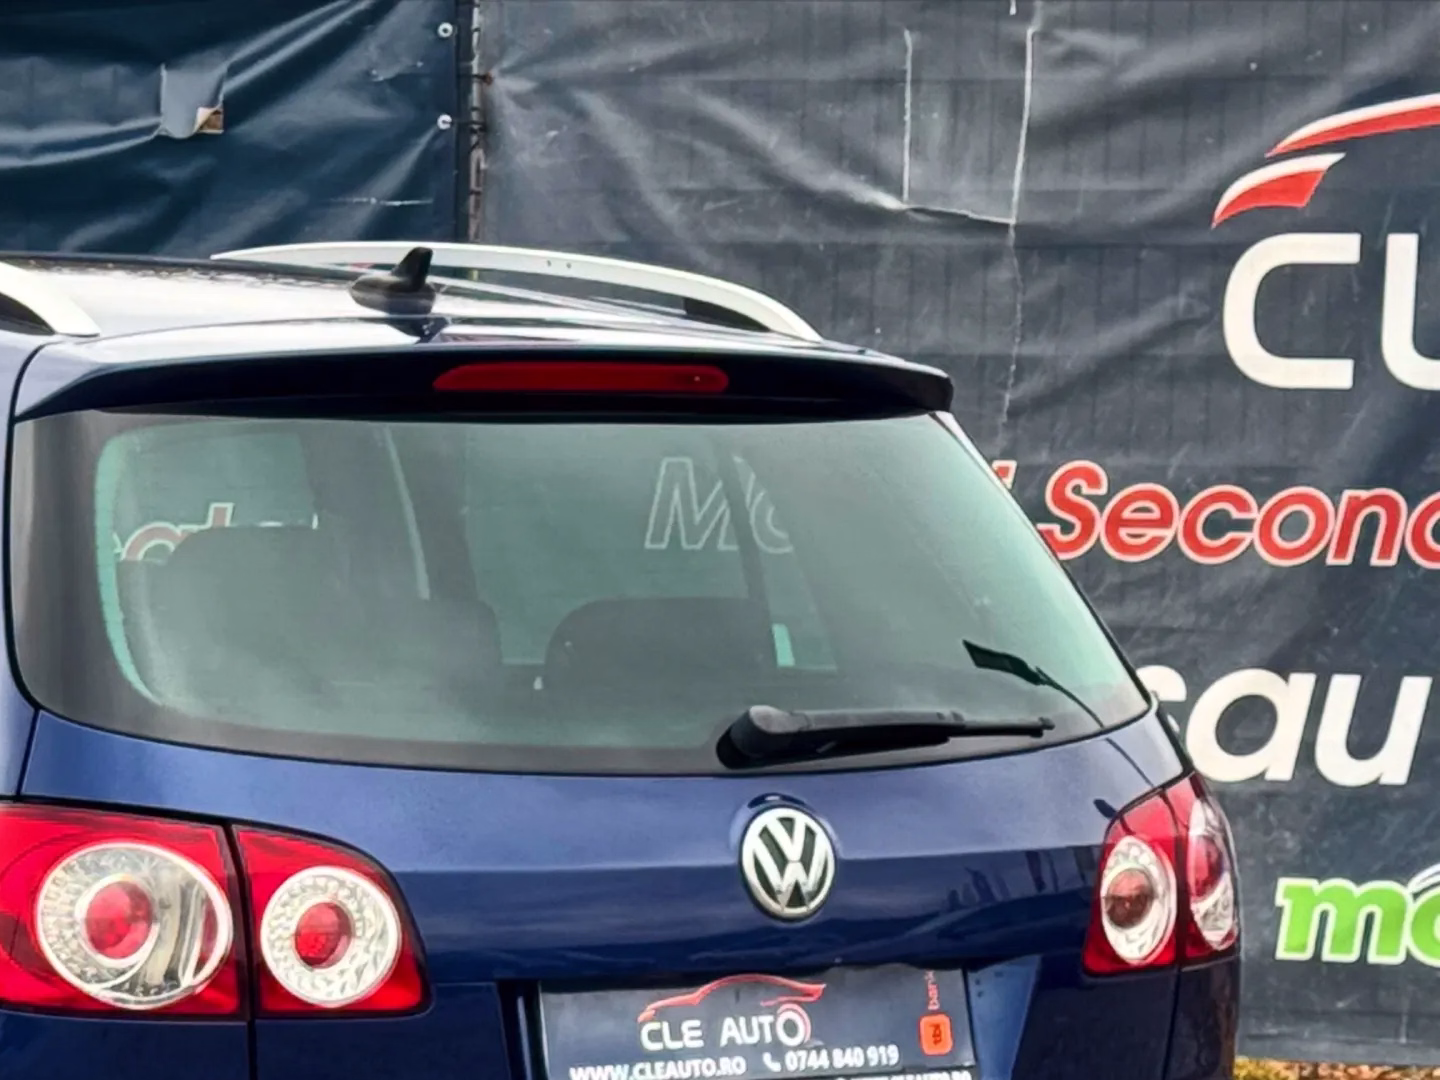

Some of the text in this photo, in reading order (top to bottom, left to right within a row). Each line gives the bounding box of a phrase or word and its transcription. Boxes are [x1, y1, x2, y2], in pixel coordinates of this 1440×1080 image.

[640, 1010, 807, 1051] CLE AUTO
[784, 1044, 900, 1072] 0744 840 919
